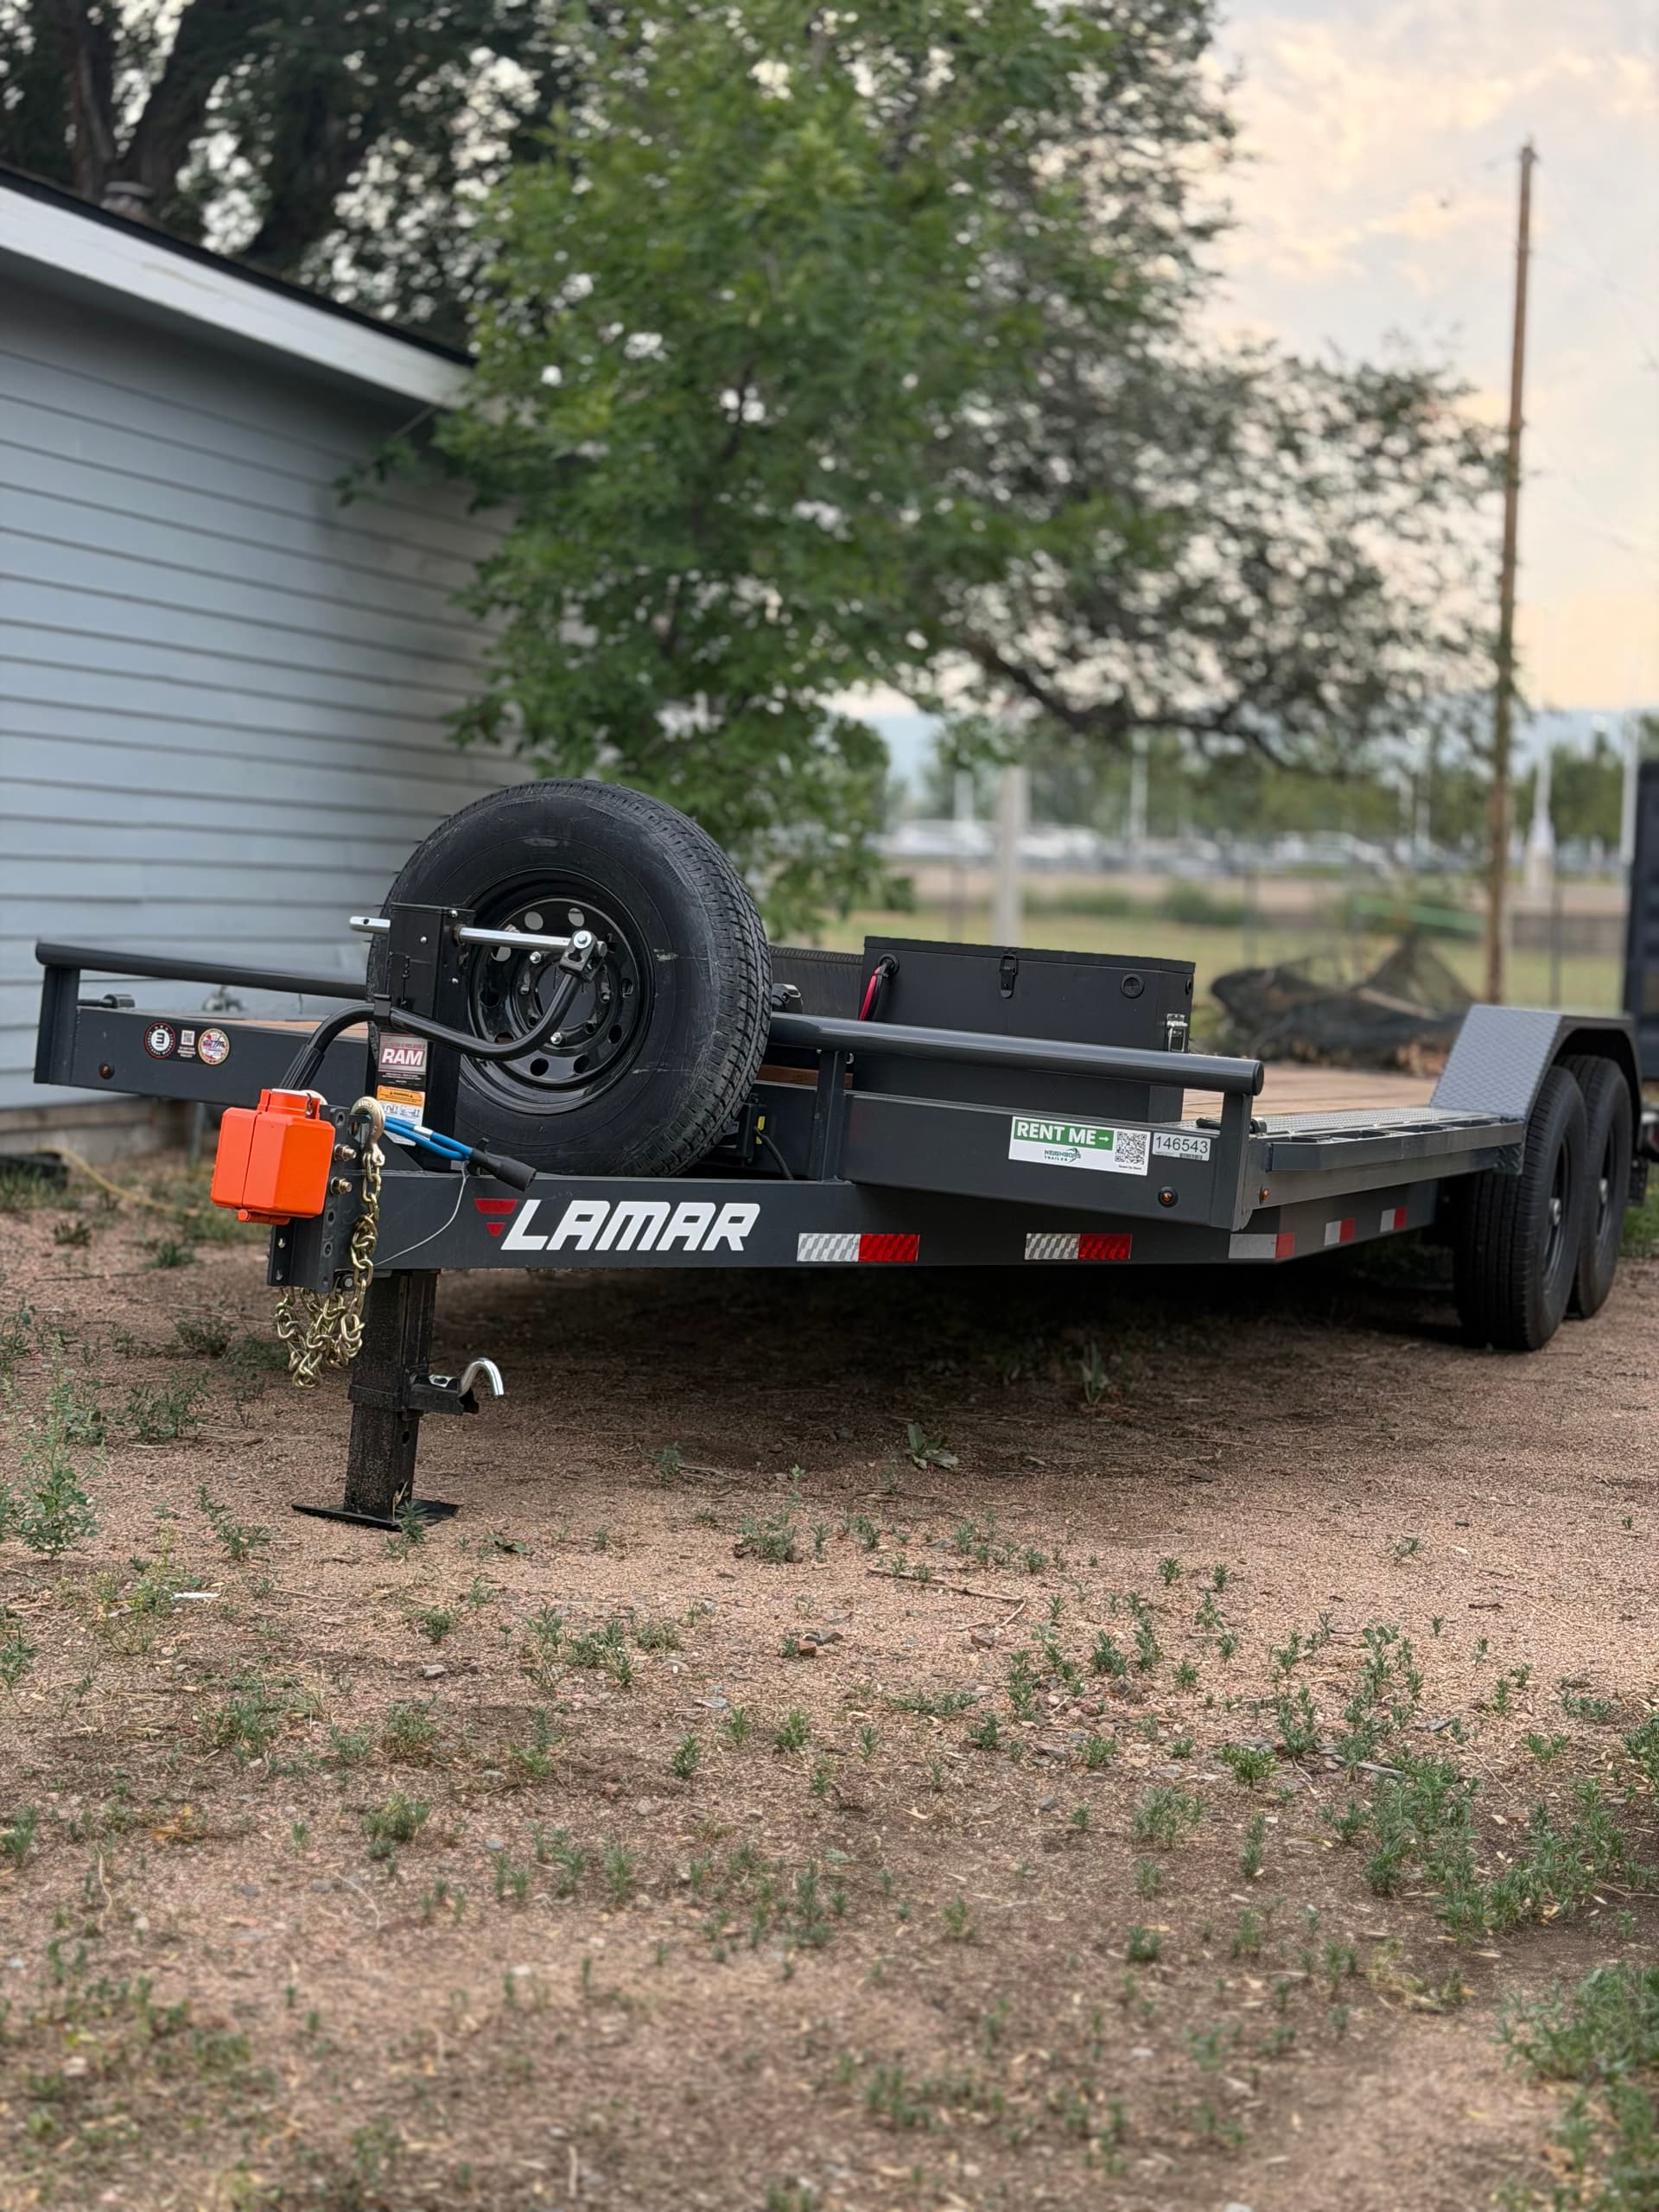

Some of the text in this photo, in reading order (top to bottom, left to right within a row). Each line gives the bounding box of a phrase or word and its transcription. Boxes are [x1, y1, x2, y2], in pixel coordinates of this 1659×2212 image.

[381, 1048, 423, 1065] RAM
[1017, 1122, 1096, 1145] RENT ME
[1156, 1135, 1208, 1154] 146543
[500, 1199, 760, 1251] LAMAR
